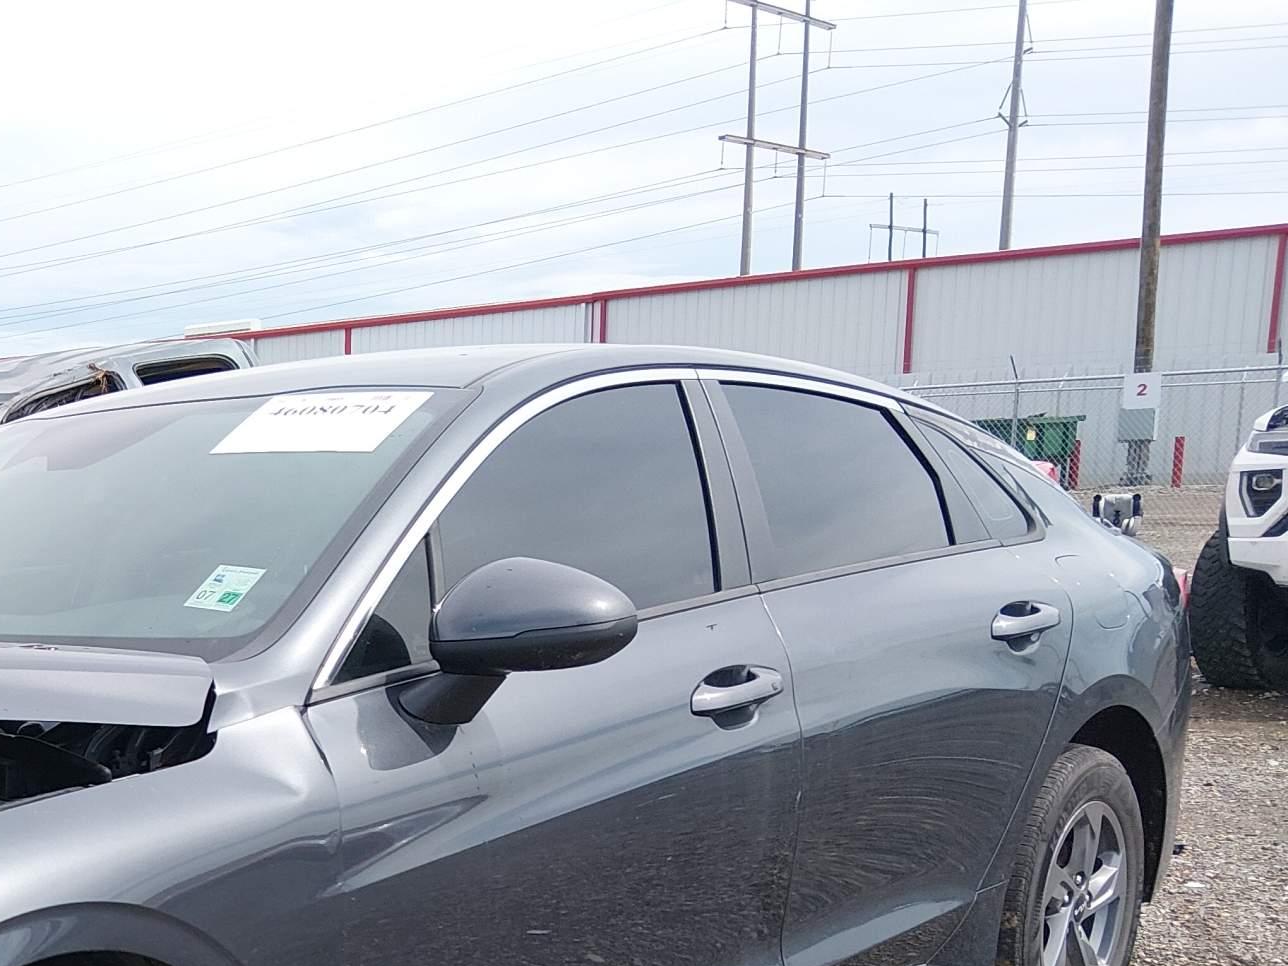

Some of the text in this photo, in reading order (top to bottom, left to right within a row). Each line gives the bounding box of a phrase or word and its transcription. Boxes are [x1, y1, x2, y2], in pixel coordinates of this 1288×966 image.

[1136, 383, 1148, 397] 2
[270, 404, 397, 415] 46080704
[196, 590, 216, 601] 07
[217, 592, 241, 605] 27
